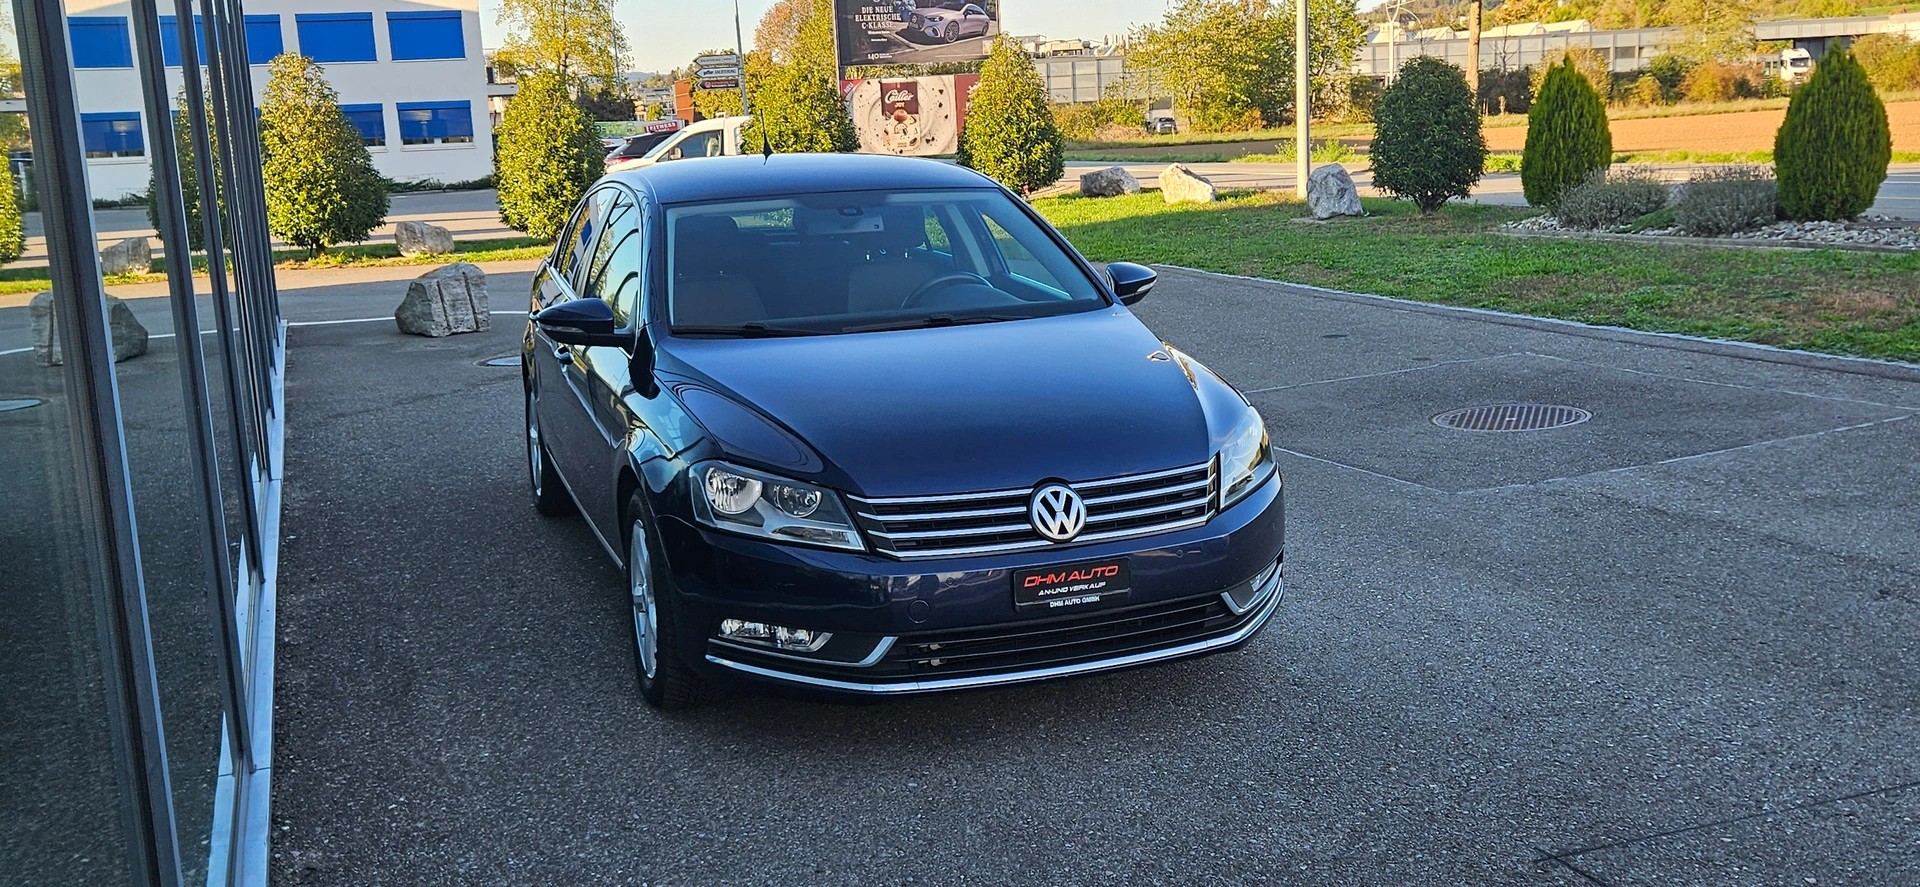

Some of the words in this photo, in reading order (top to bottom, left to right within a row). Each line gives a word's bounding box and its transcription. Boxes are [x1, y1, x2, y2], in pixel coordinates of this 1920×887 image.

[861, 6, 873, 14] DIE
[875, 5, 893, 13] NEUE
[854, 13, 902, 22] ELEKTRISCHE
[884, 89, 914, 104] Cailler
[649, 121, 677, 131] FITNESS
[1034, 487, 1084, 538] VW
[1024, 572, 1066, 588] DHM
[1067, 565, 1119, 582] AUTO
[1038, 587, 1069, 597] AN-UND
[1069, 581, 1106, 592] VERKAUF
[1049, 599, 1064, 608] DHM
[1064, 597, 1081, 606] AUTO
